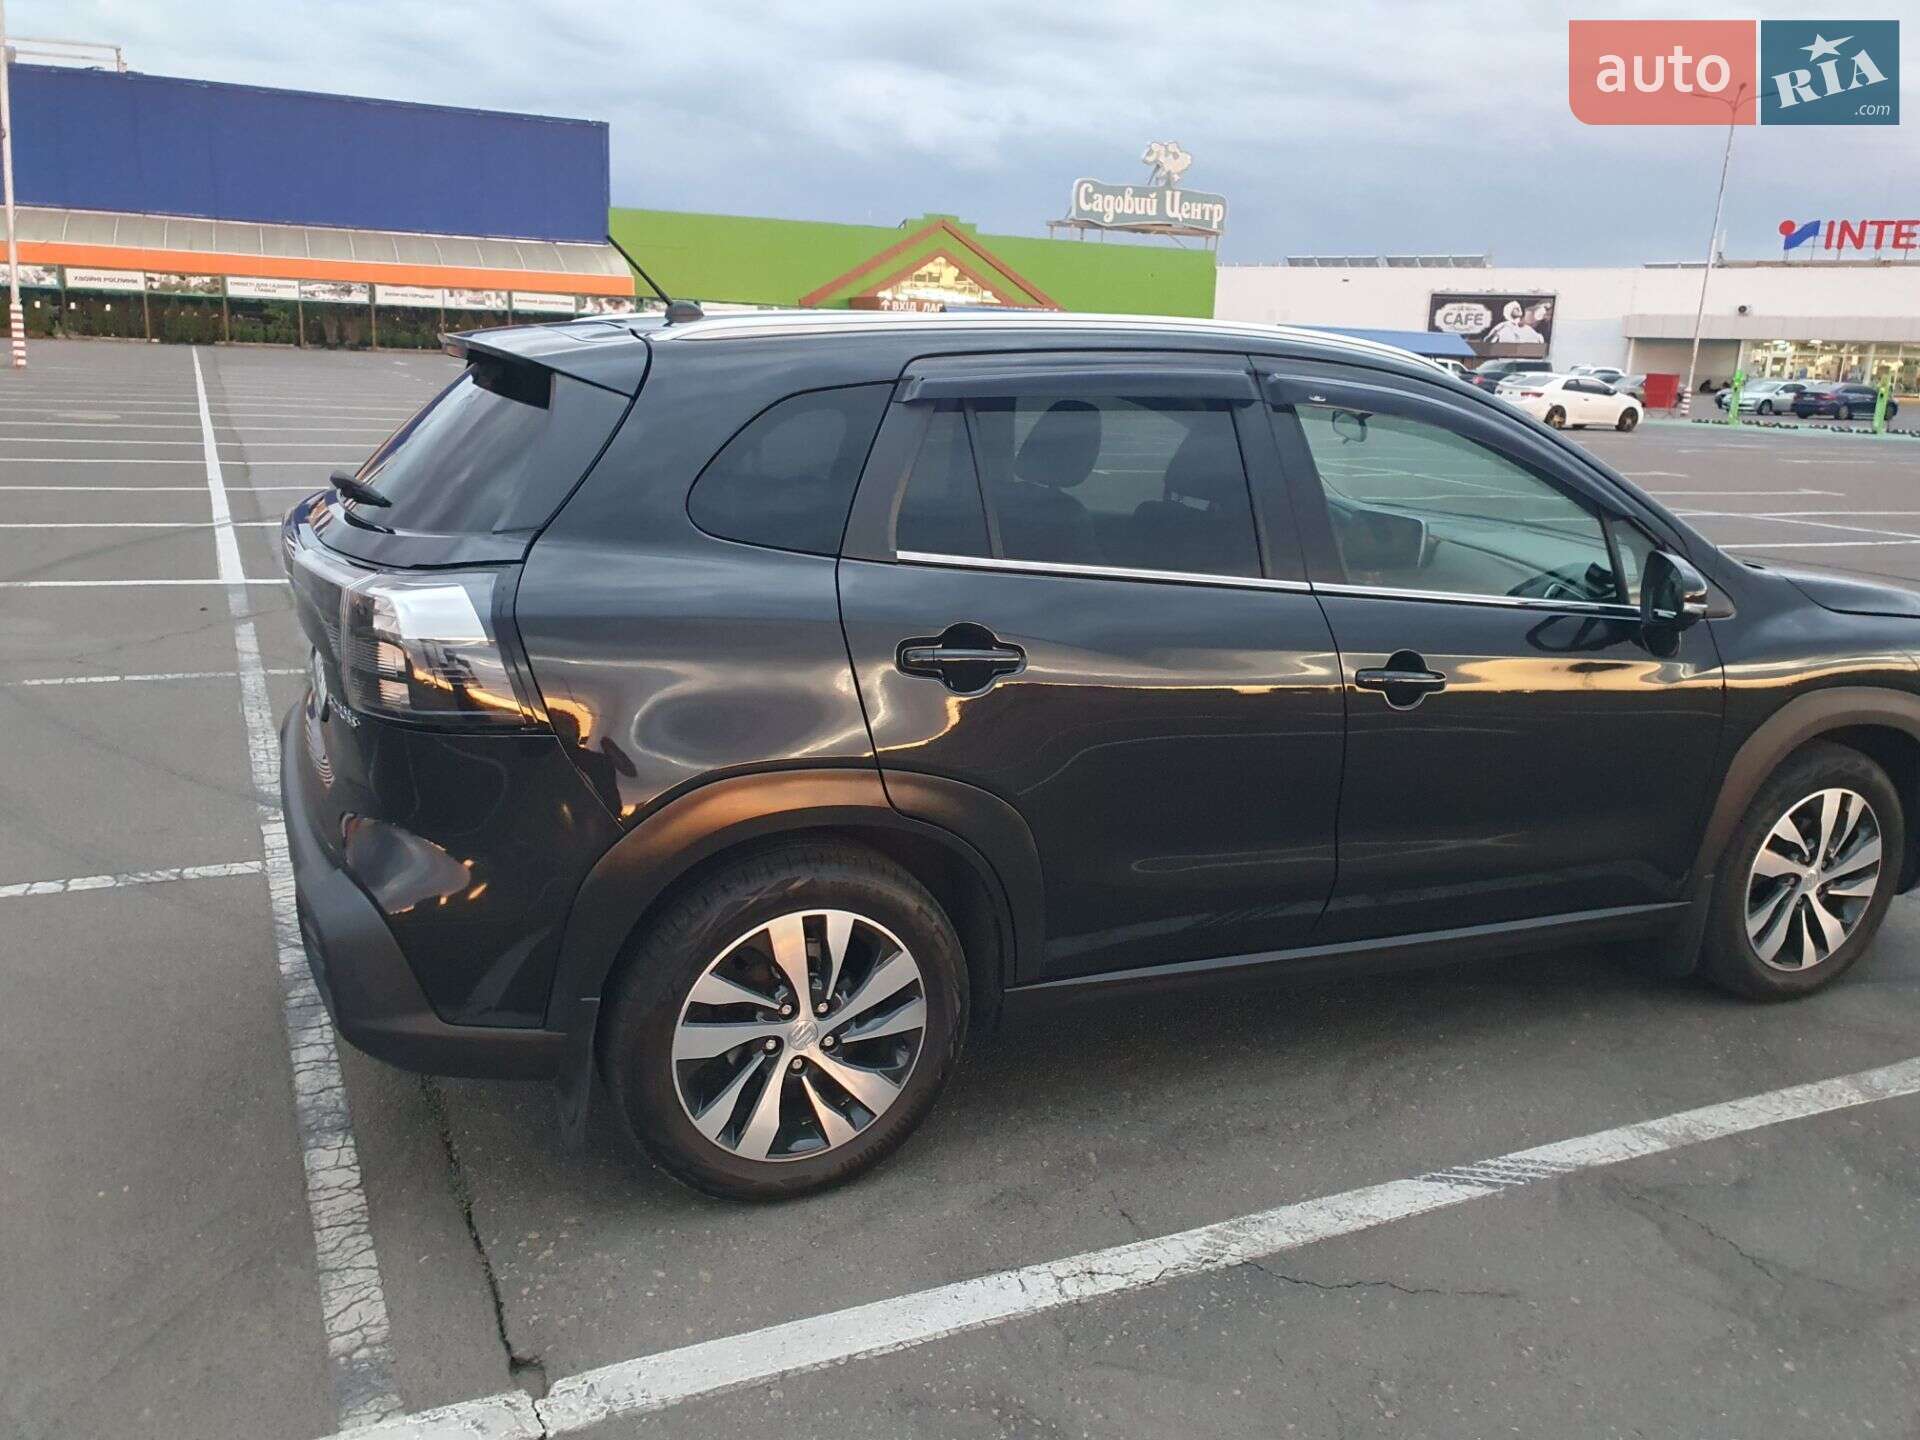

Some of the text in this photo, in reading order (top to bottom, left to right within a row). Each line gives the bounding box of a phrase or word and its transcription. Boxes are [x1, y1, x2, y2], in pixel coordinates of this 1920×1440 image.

[1079, 183, 1224, 229] Садовий Центр
[1824, 219, 1920, 250] INTE
[1443, 312, 1484, 326] CAFE
